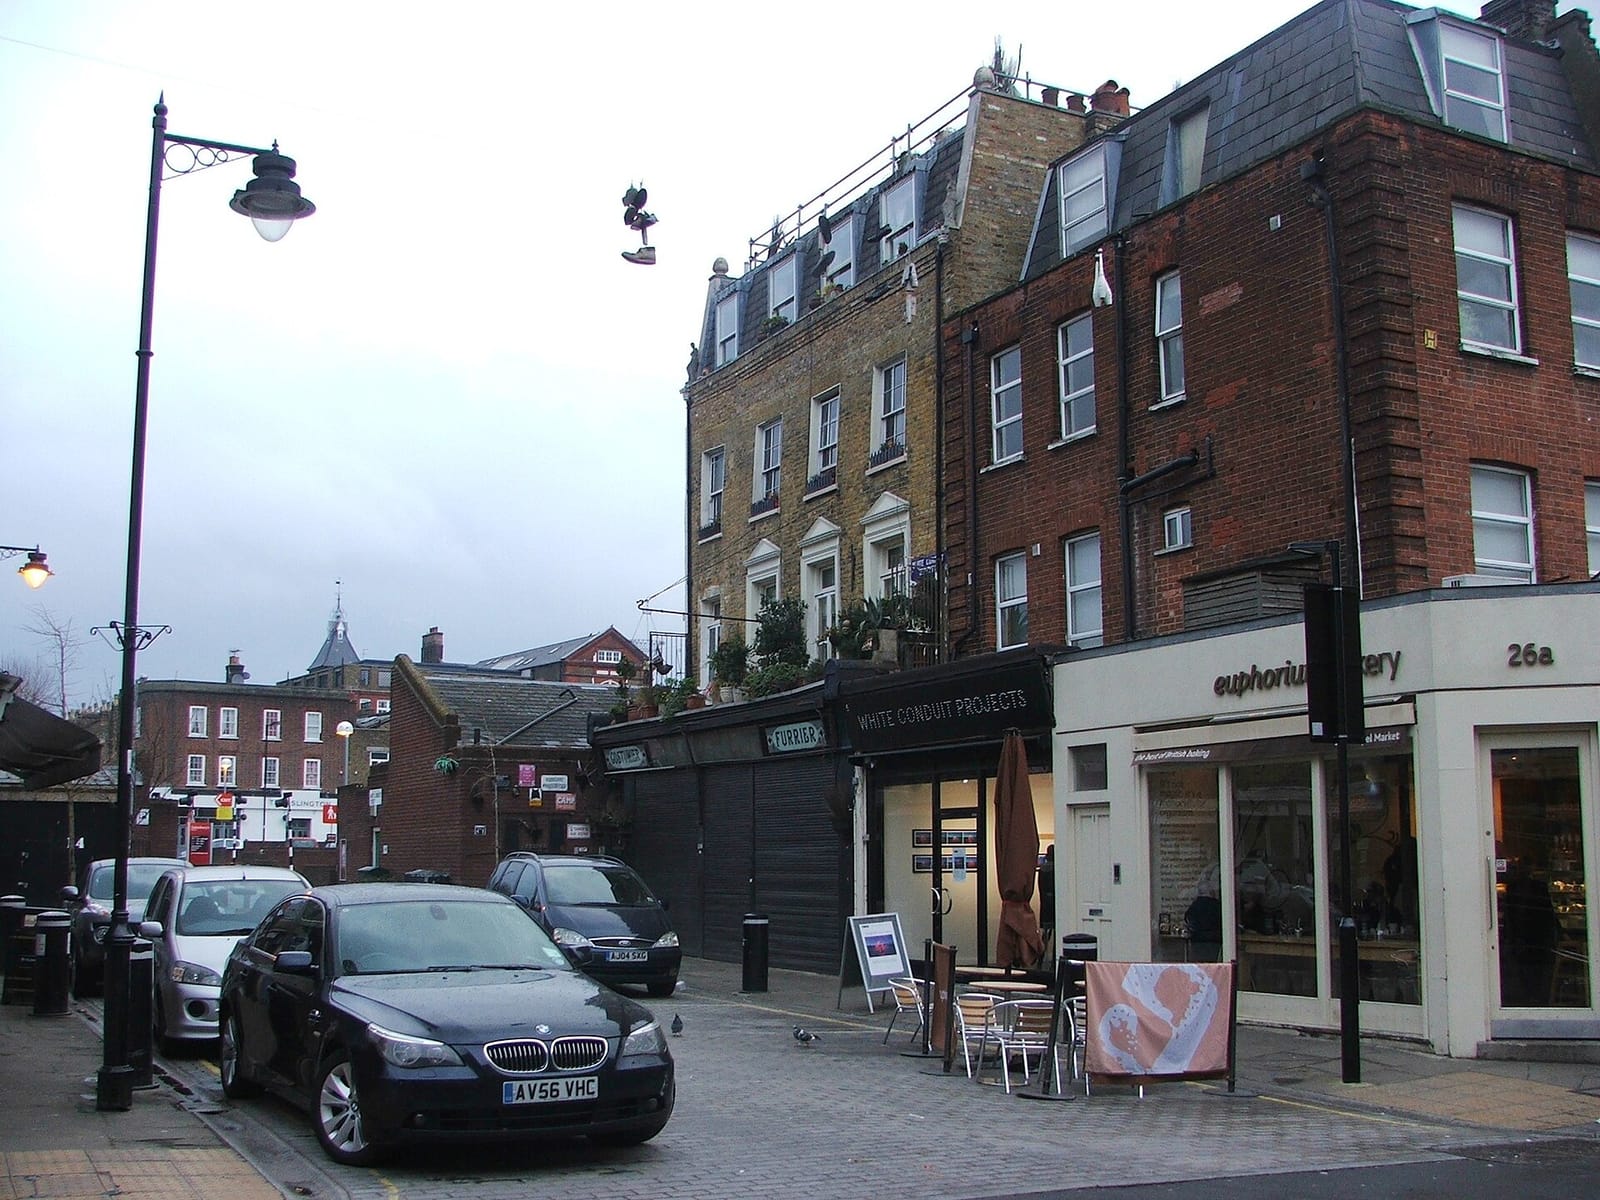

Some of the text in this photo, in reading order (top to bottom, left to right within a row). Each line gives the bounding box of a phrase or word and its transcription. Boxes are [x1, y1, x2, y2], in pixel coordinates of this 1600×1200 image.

[1508, 643, 1554, 667] 26a
[1213, 650, 1402, 698] euphoriu ery
[857, 689, 1027, 731] WHITE CONDUIT PROJECTS
[775, 726, 817, 747] FURRIER
[1374, 731, 1400, 743] Market
[1145, 752, 1159, 760] best
[1158, 751, 1167, 759] of
[1165, 750, 1186, 759] British
[1186, 748, 1210, 759] baking
[515, 1079, 596, 1101] AV56 VHC
